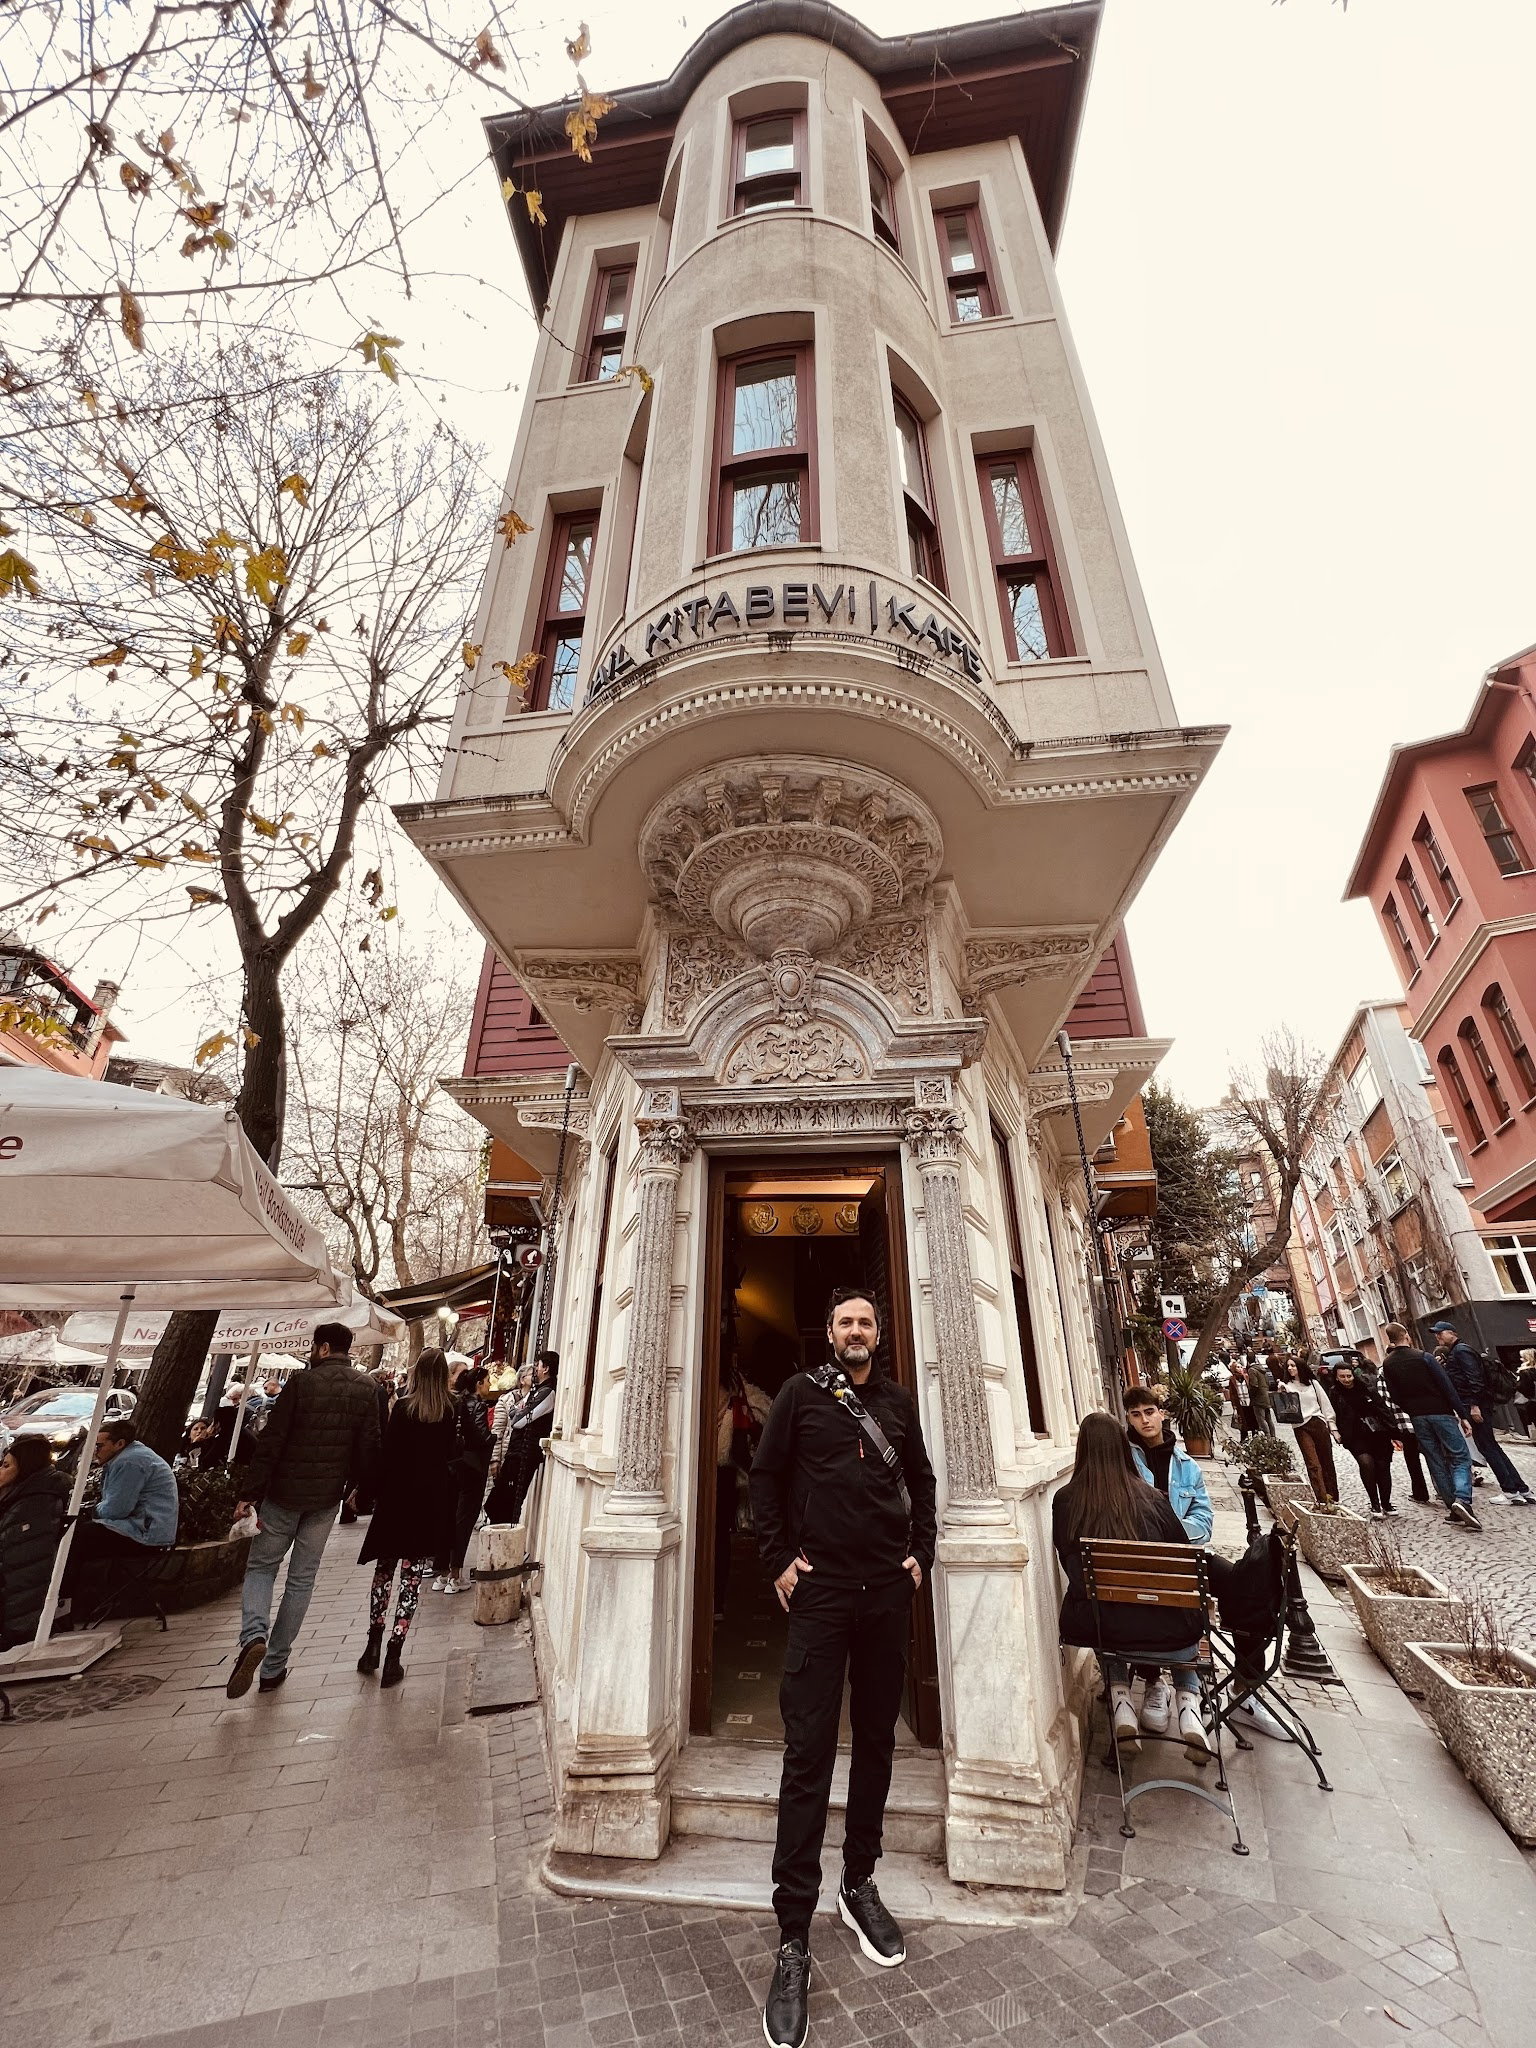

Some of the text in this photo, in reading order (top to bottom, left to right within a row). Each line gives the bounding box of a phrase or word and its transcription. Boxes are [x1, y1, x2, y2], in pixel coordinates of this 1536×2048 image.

[887, 595, 983, 684] KAFE
[266, 1189, 294, 1240] Bookstore
[274, 1318, 309, 1333] Cafe
